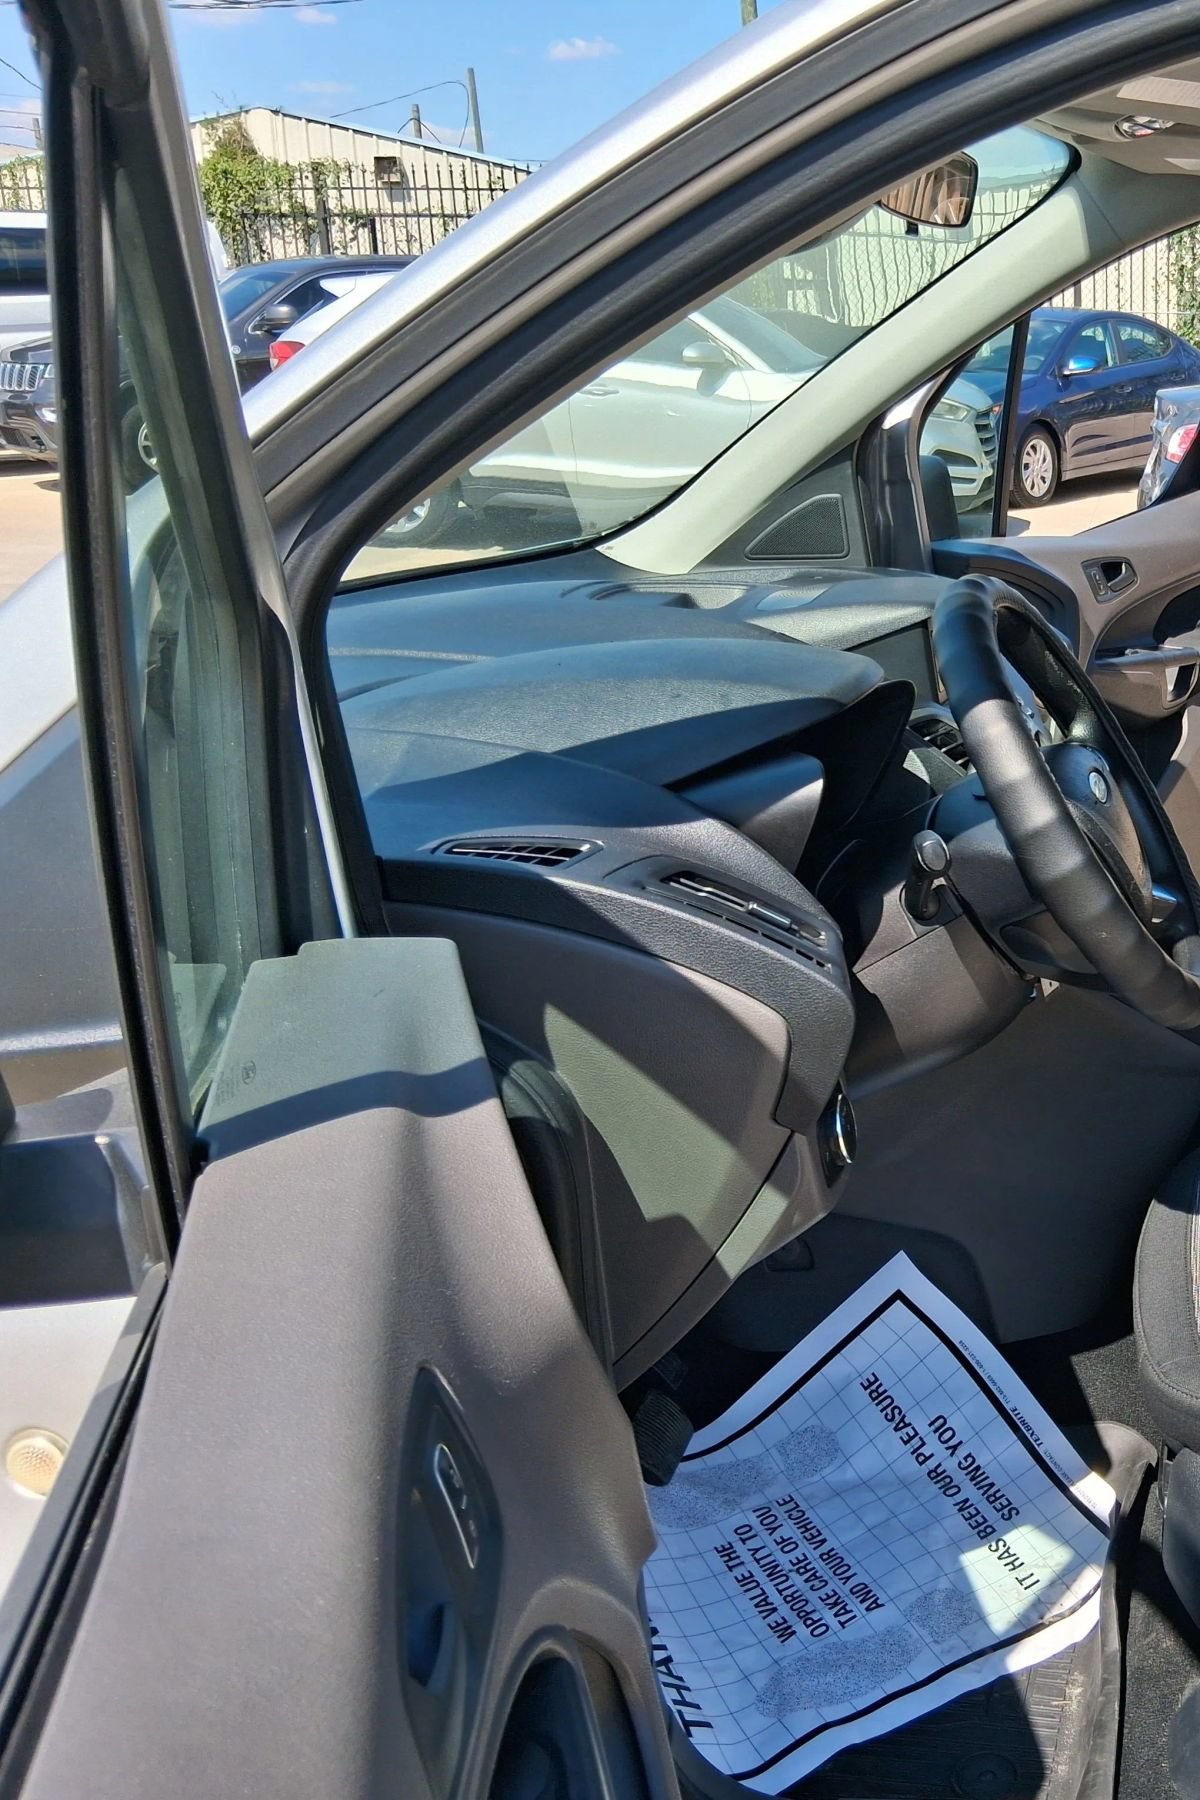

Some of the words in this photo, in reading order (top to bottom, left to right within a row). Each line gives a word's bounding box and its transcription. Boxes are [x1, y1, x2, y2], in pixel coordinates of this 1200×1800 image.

[859, 1371, 935, 1467] PLEASURE
[927, 1414, 964, 1458] YOU
[1008, 1404, 1045, 1448] TEXBRITE
[926, 1462, 962, 1498] OUR
[957, 1452, 1020, 1522] SERVING
[733, 1523, 759, 1546] TO
[751, 1506, 784, 1537] YOU
[775, 1493, 828, 1551] VEHICLE
[952, 1497, 998, 1541] BEEN
[713, 1541, 745, 1573] THE
[772, 1535, 800, 1555] OF
[987, 1533, 1025, 1572] HAS
[788, 1552, 829, 1592] CARE
[818, 1546, 858, 1586] YOUR
[1015, 1572, 1041, 1591] IT
[733, 1569, 779, 1621] VALUE
[746, 1544, 830, 1638] OPPORTUNITY
[817, 1588, 858, 1630] TAKE
[848, 1582, 886, 1613] AND
[766, 1615, 798, 1644] WE
[648, 1616, 714, 1738] THA
